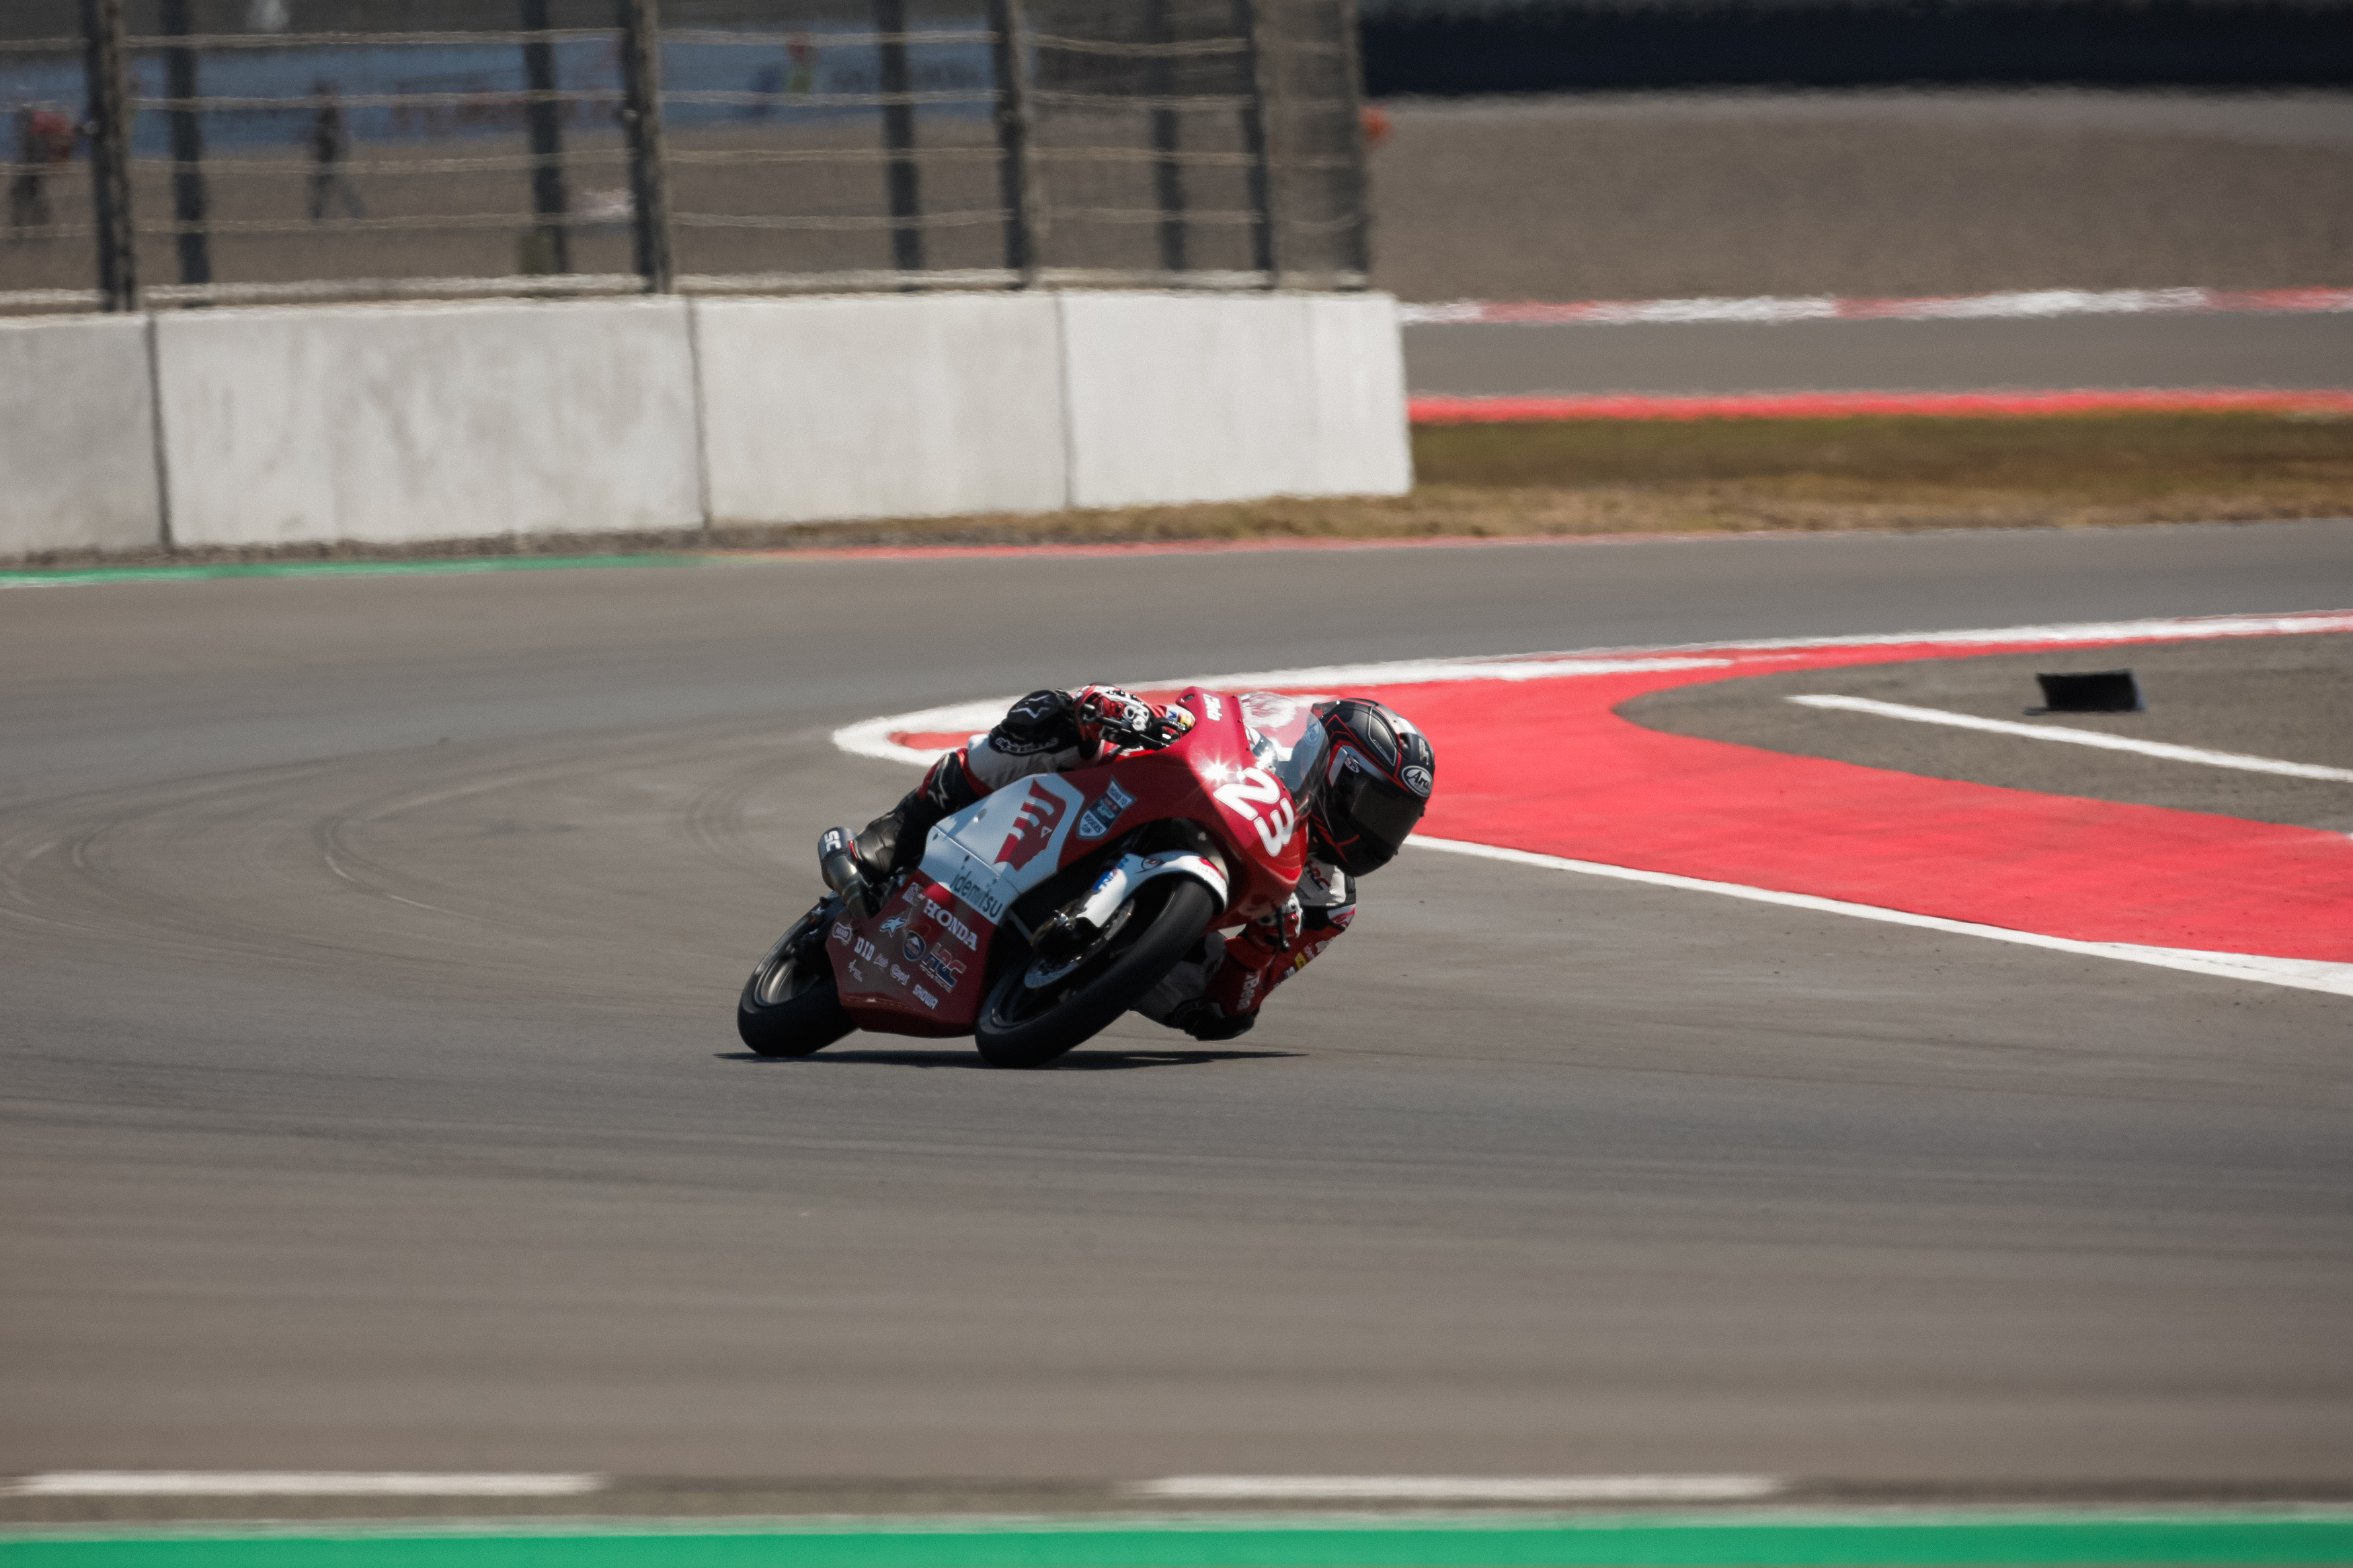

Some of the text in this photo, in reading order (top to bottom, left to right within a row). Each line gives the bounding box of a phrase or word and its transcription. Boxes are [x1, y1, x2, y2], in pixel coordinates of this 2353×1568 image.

[1213, 767, 1295, 858] 23
[824, 830, 842, 852] SC
[949, 865, 1003, 918] idemitsu
[922, 898, 978, 952] HONDA
[922, 942, 967, 989] HRC
[912, 983, 939, 1010] SHOWA
